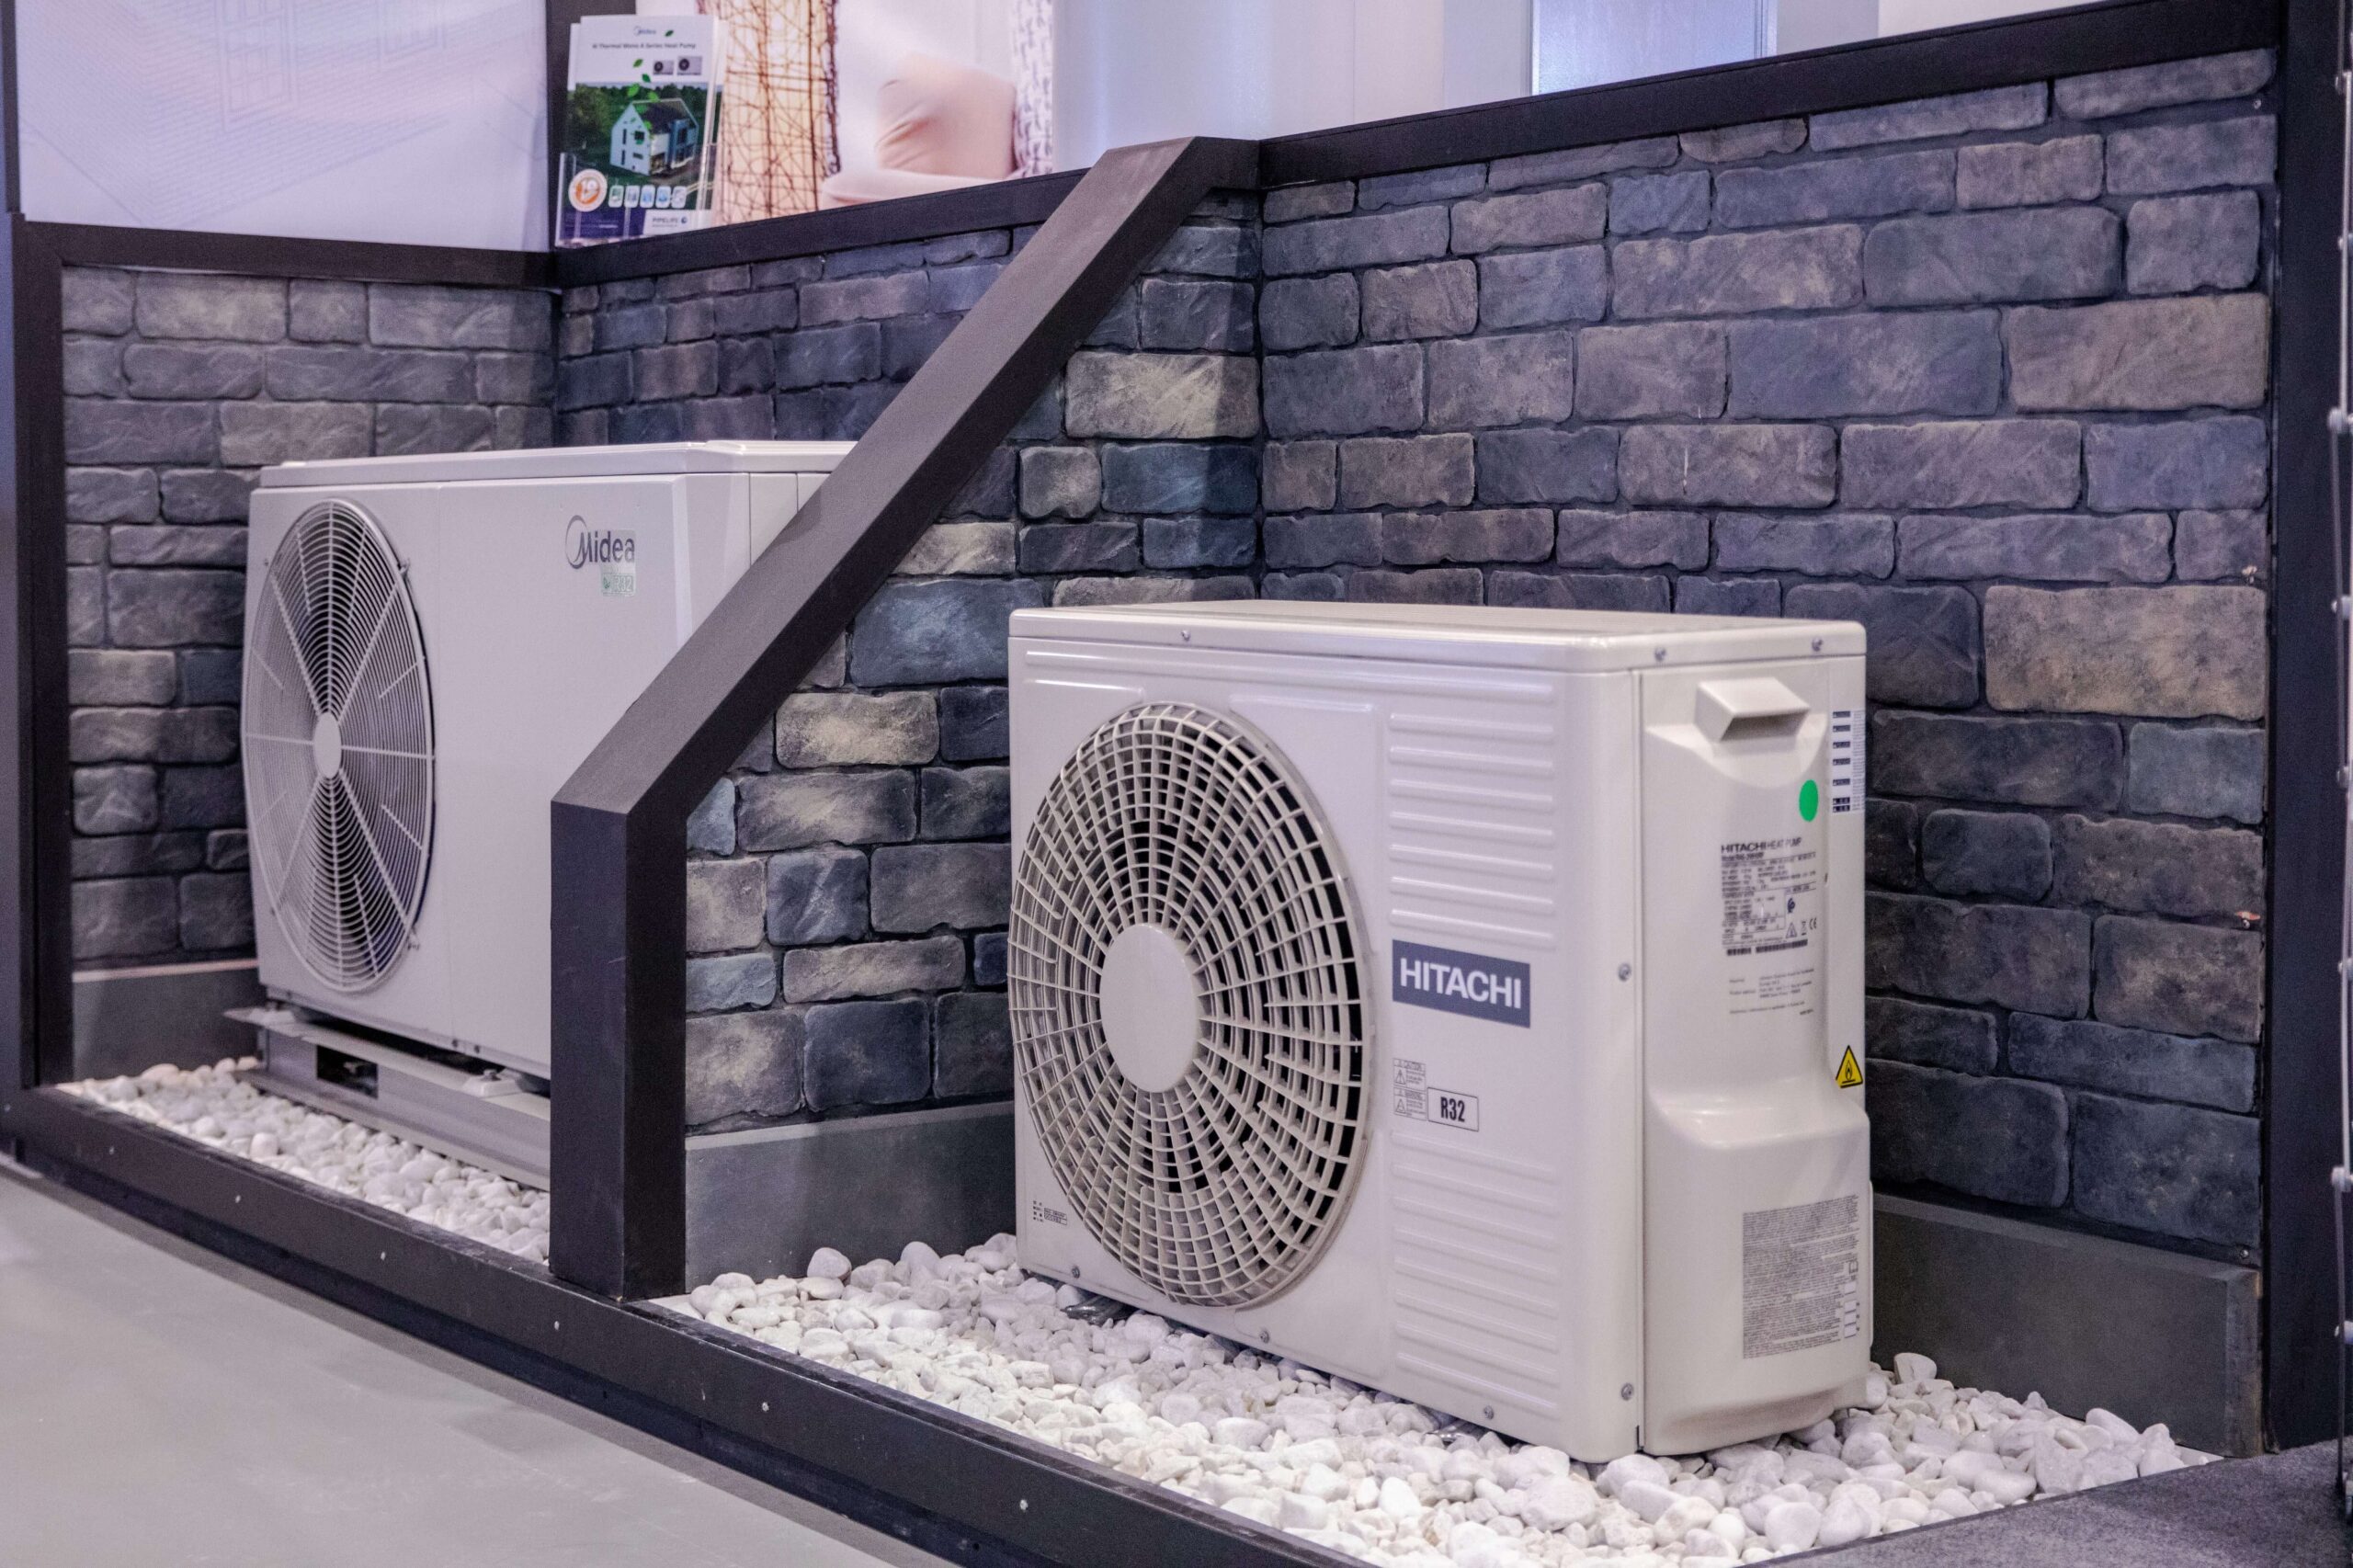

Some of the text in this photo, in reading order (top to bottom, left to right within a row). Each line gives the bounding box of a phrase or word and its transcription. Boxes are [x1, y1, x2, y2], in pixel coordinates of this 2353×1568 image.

[565, 515, 635, 570] Midea
[1722, 842, 1766, 853] HITACHI
[1400, 958, 1522, 1009] HITACHI
[1439, 1096, 1465, 1123] R32
